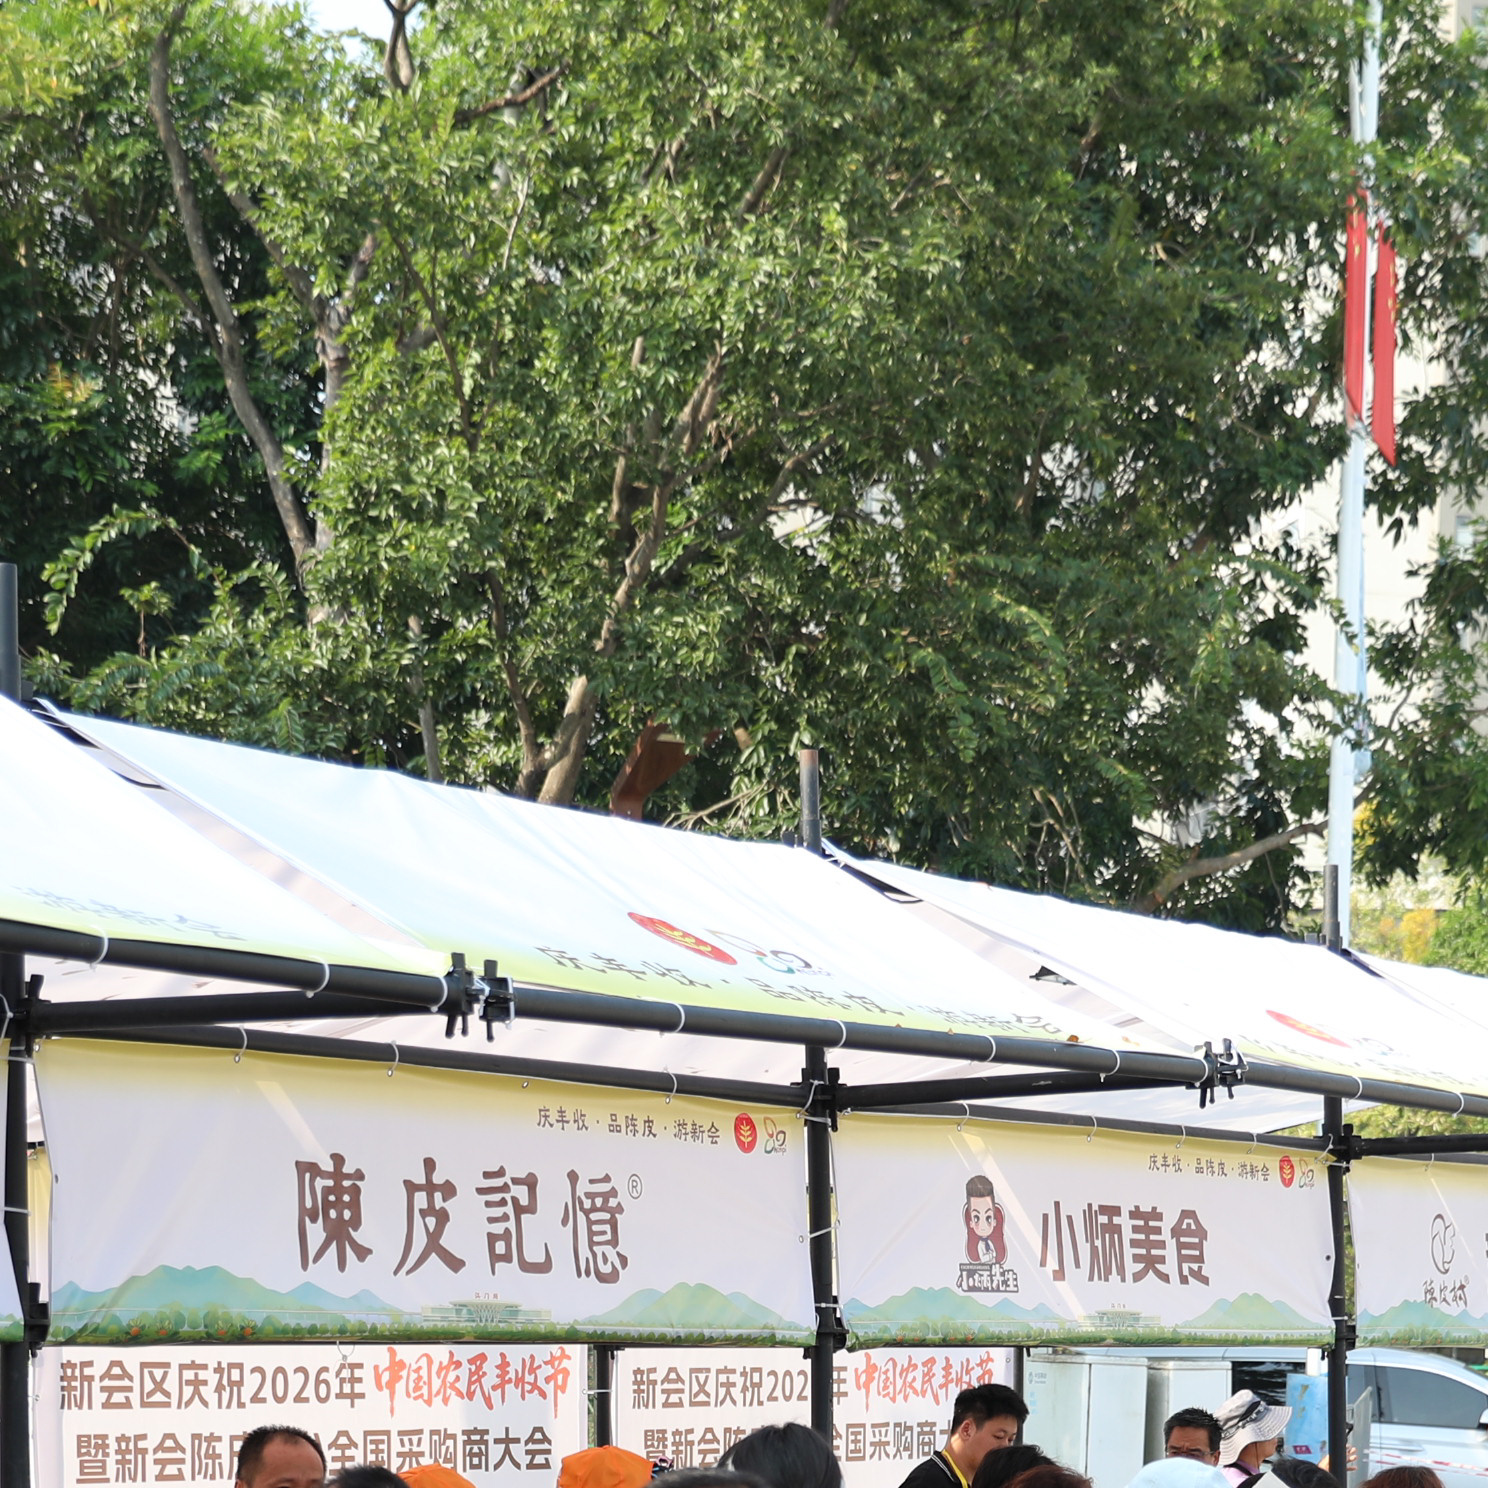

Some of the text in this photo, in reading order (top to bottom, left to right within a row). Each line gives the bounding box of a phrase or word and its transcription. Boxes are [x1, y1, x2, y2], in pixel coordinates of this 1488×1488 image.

[294, 1153, 629, 1285] 陳皮記憶
[1039, 1201, 1211, 1287] 小炳美食
[59, 1346, 572, 1419] 新会区庆祝2026年 中国农民丰收节
[632, 1366, 849, 1409] 新会区庆祝202年
